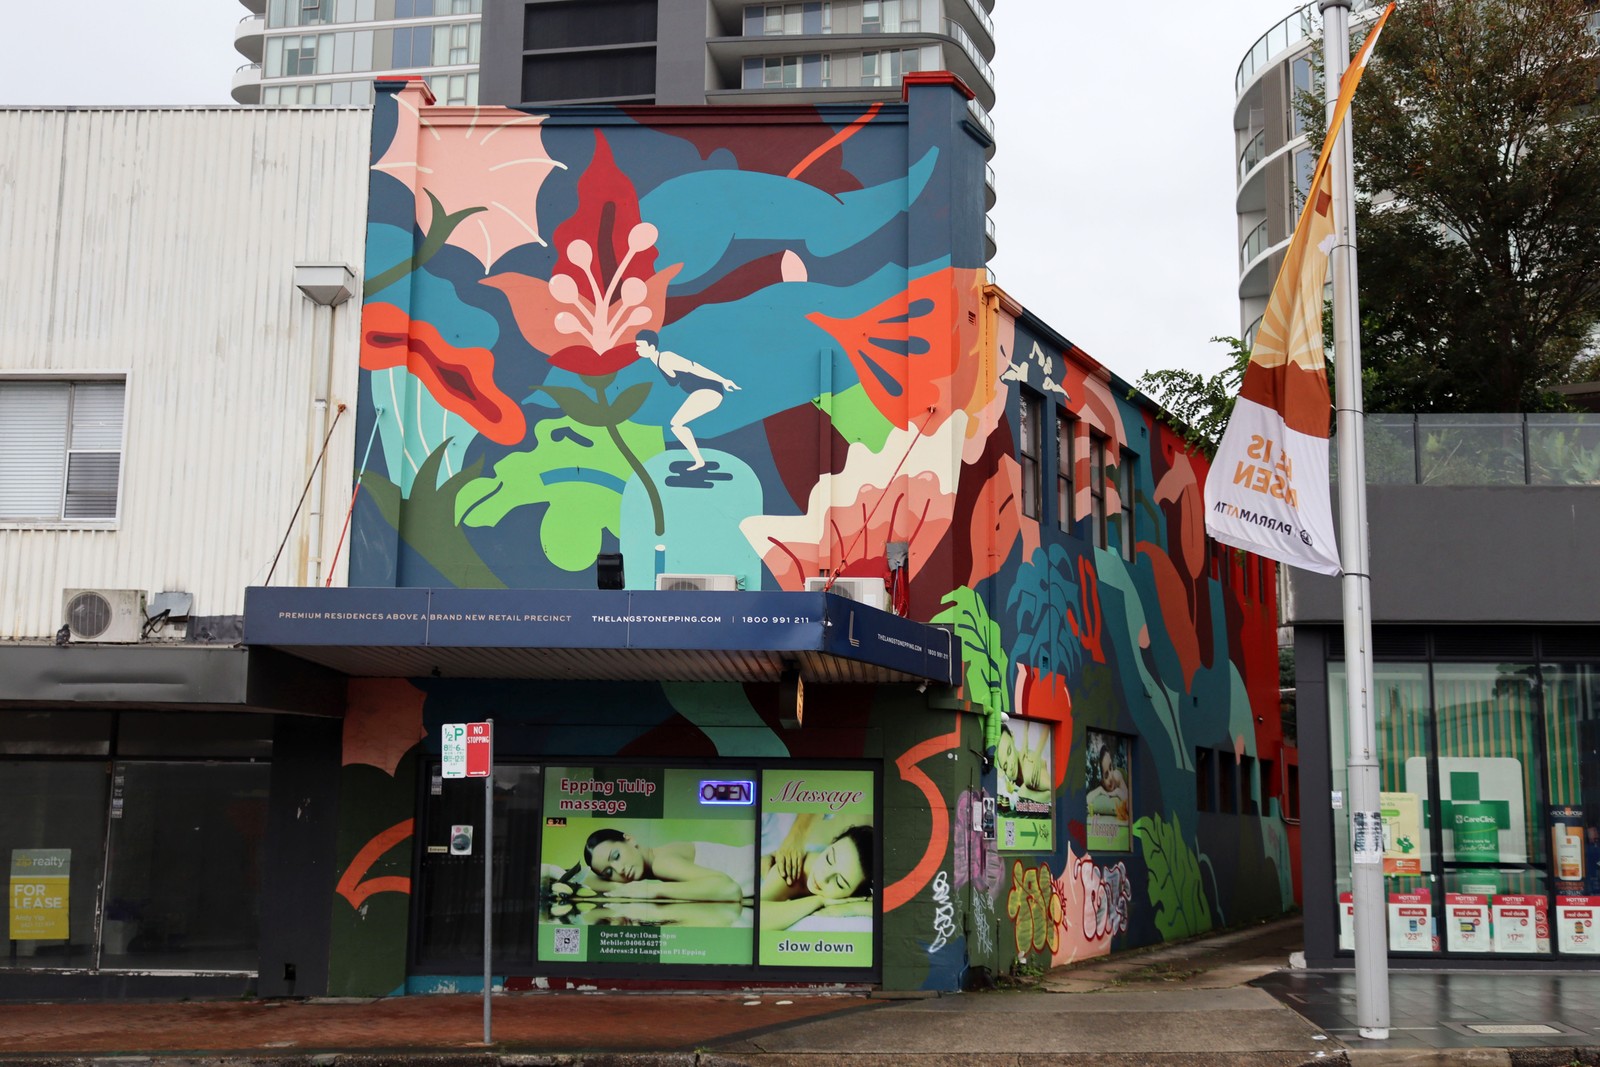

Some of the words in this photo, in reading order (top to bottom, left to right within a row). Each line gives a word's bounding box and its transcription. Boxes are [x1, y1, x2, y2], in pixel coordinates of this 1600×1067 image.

[324, 612, 384, 620] RESIDENCES
[592, 615, 721, 623] THELANGSTONEPPING.COM
[772, 616, 790, 624] 991
[877, 633, 922, 652] THELANGSTONEPPING.COM
[473, 726, 484, 735] NO
[467, 736, 490, 744] STOPPING
[560, 777, 614, 796] Epping
[617, 778, 656, 796] Tulip
[702, 784, 750, 801] OPEN
[770, 780, 863, 811] Massage
[560, 799, 627, 814] massage
[14, 884, 46, 896] FOR
[14, 897, 63, 909] LEASE
[600, 931, 619, 939] Open
[778, 939, 811, 952] slow
[814, 940, 854, 953] down
